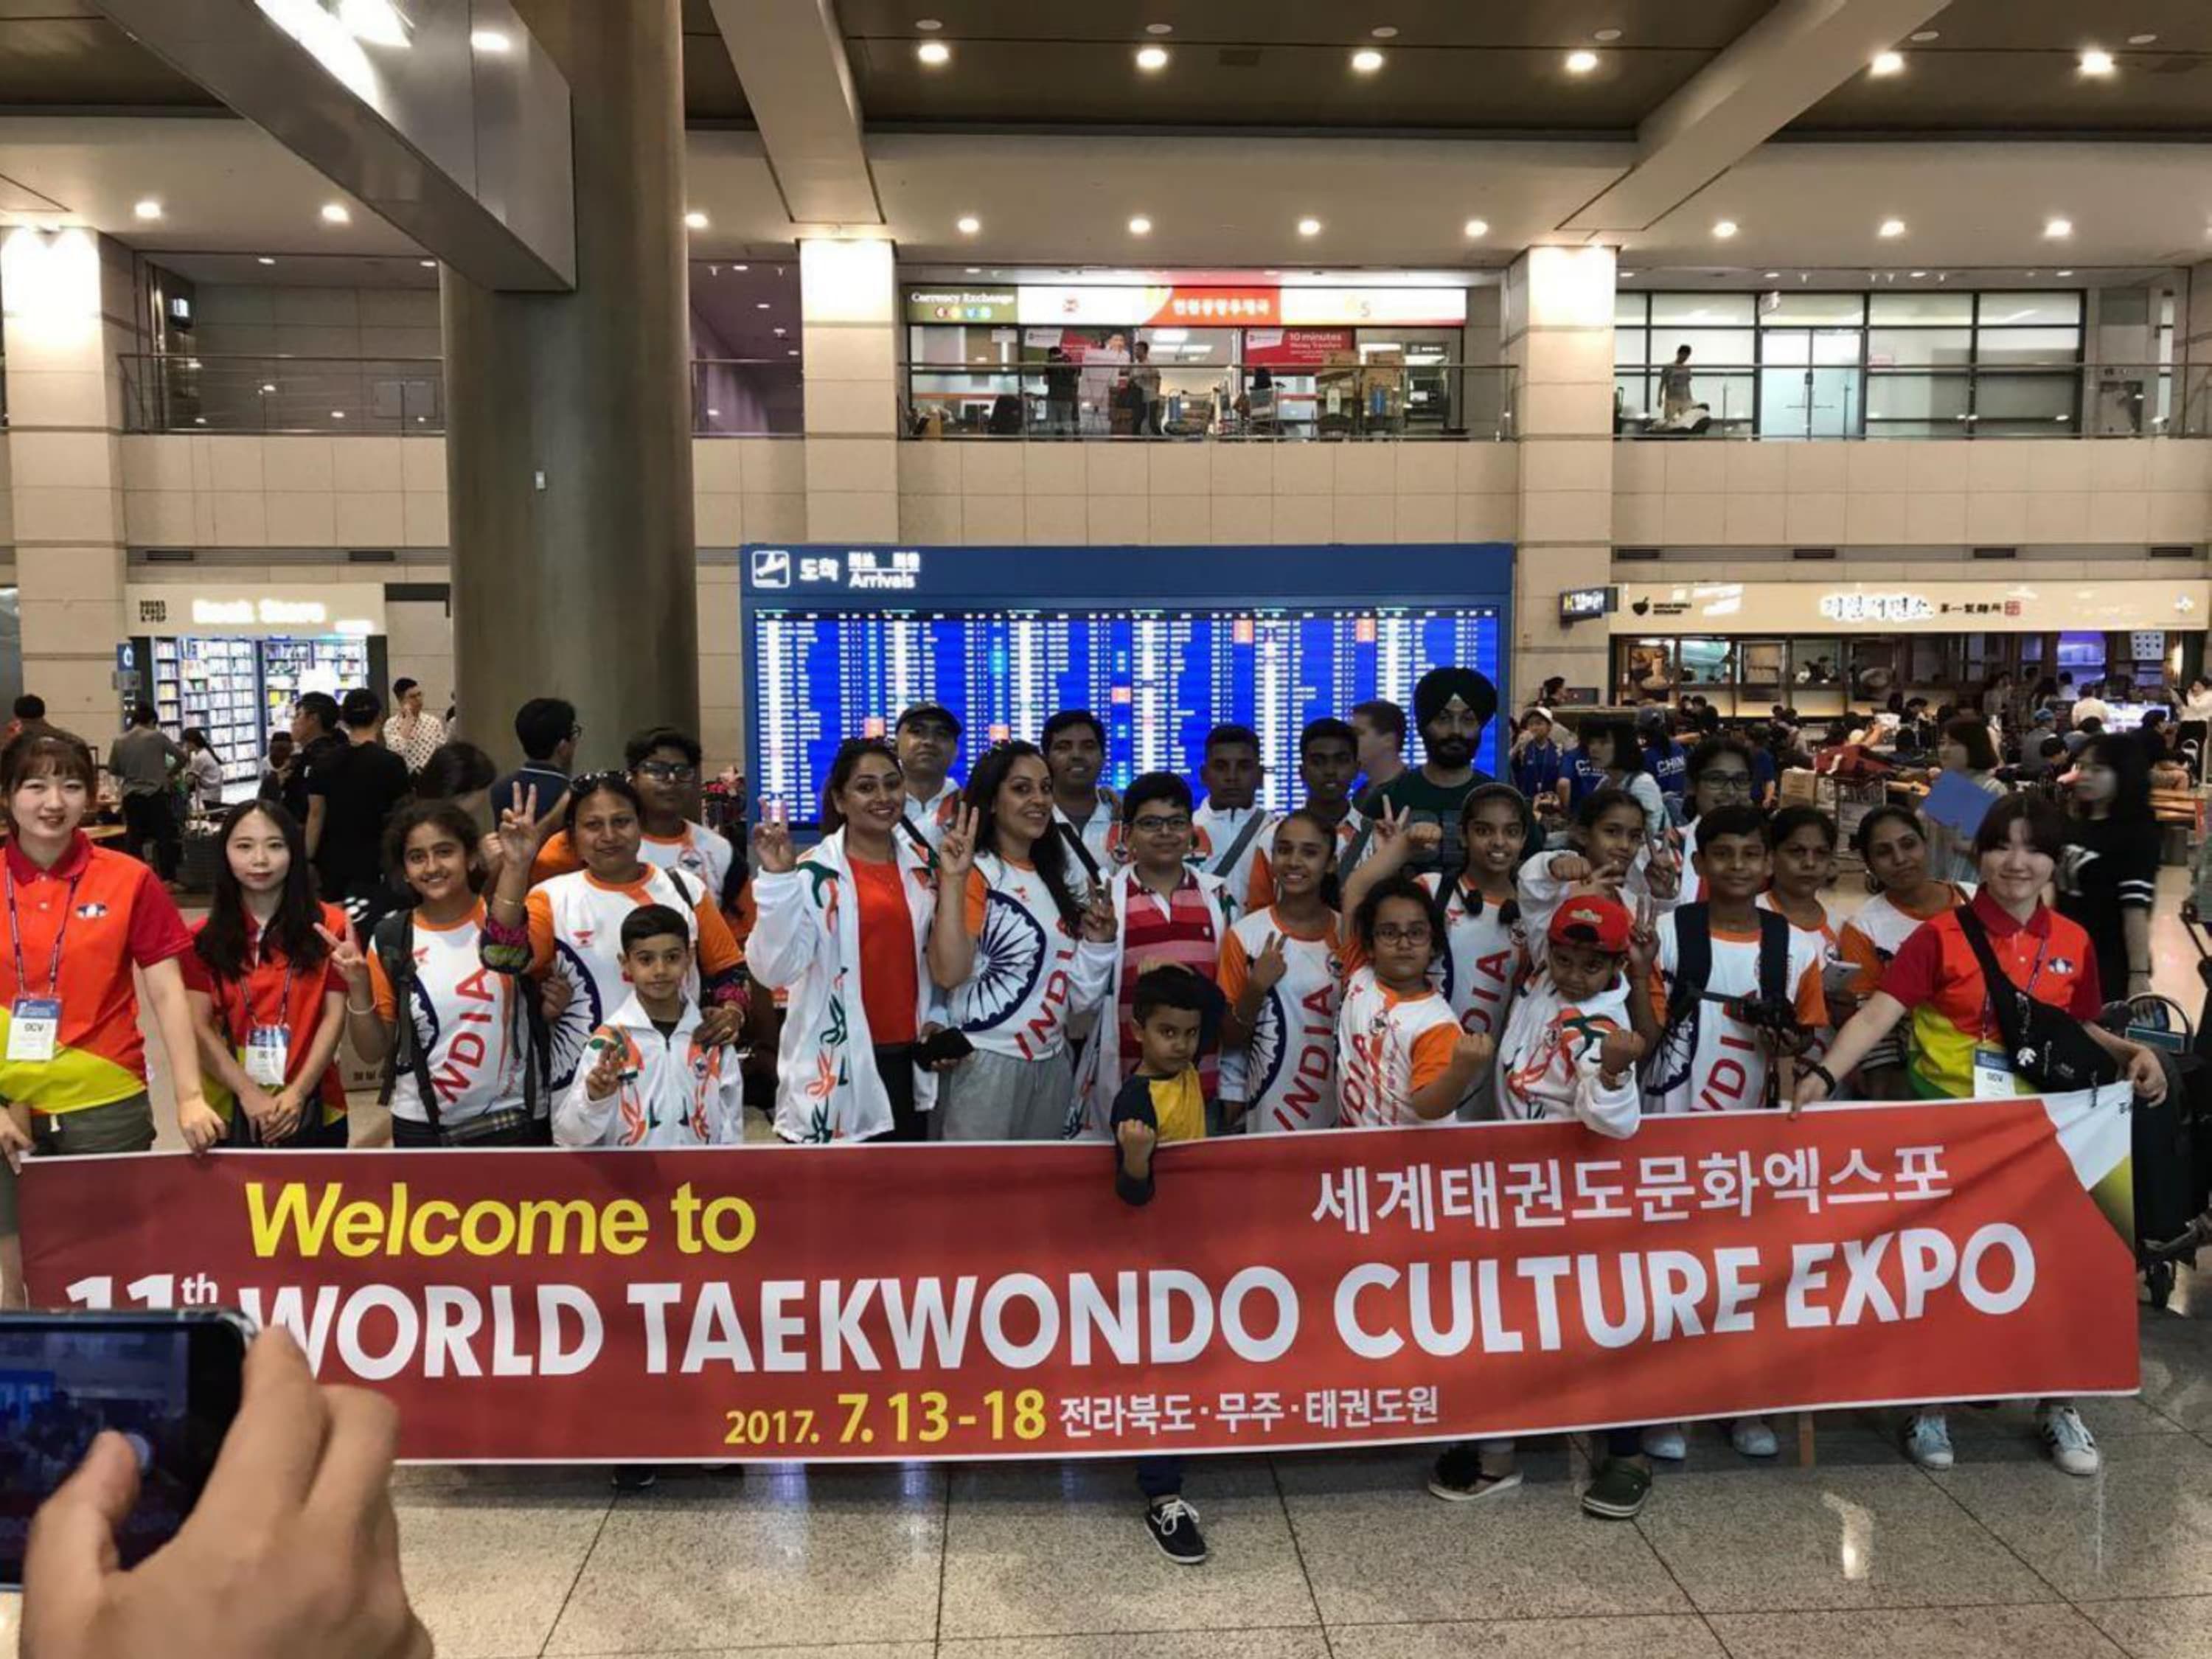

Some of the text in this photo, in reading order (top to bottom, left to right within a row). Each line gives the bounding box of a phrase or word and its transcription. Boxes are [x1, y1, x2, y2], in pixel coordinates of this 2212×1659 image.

[1290, 332, 1300, 341] 10
[1301, 333, 1342, 341] minutes
[848, 571, 916, 588] Arrivals
[432, 967, 495, 1105] NDIA
[1273, 984, 1333, 1132] INDIA
[246, 1182, 756, 1258] Welcome to
[1312, 1144, 1953, 1234] 세계태권도문화엑스포
[238, 1284, 604, 1380] WORLD
[627, 1265, 1299, 1374] TAEKWONDO
[1333, 1246, 1761, 1360] CULTURE
[1785, 1222, 2036, 1329] EXPO
[724, 1410, 821, 1445] 2017.
[838, 1393, 874, 1443] 7.
[888, 1388, 1046, 1443] 13-18
